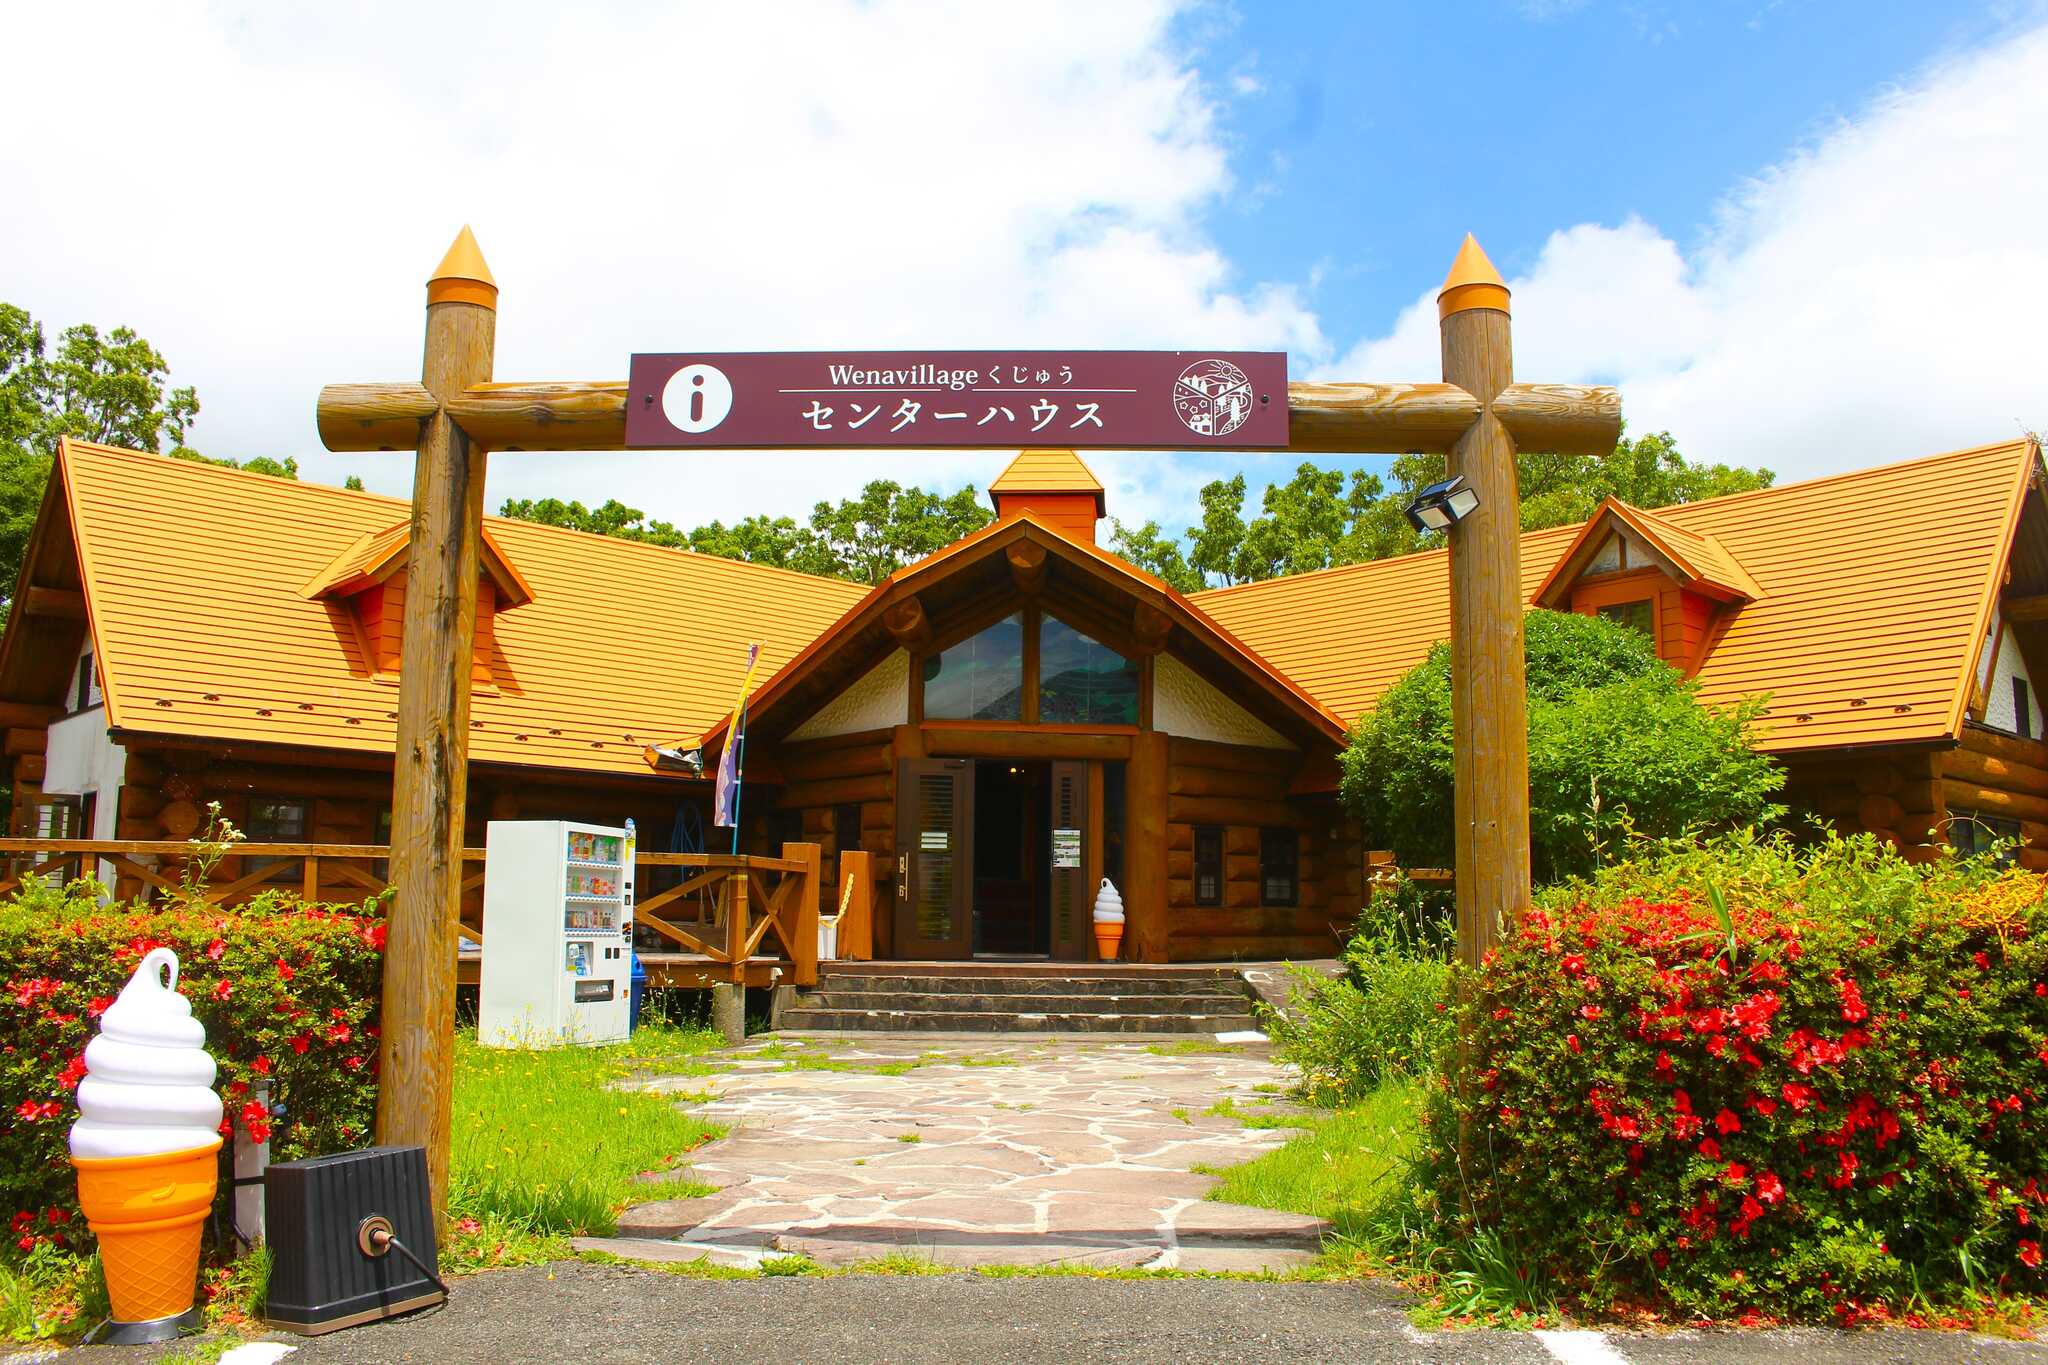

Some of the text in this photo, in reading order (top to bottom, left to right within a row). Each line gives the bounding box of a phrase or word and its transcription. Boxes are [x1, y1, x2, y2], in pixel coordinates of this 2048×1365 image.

[828, 363, 1074, 391] Wenavillage くじゅう
[801, 398, 1105, 433] センターハウス
